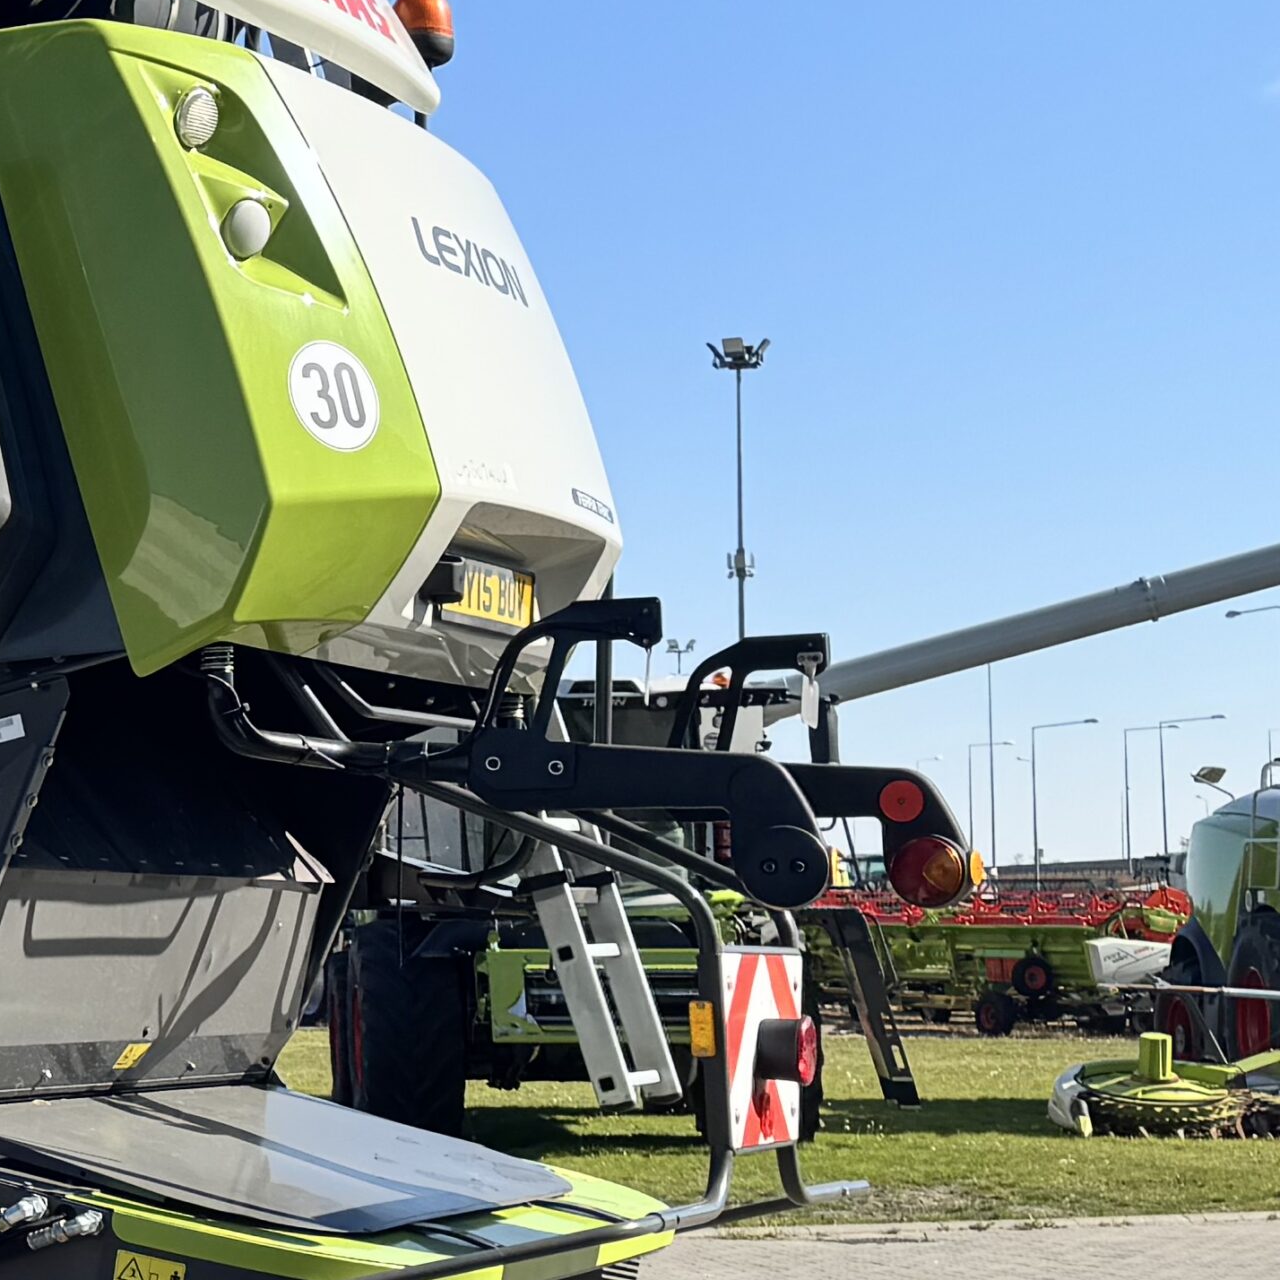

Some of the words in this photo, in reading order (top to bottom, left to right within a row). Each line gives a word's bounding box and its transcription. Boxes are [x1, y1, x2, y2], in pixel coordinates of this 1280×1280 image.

[410, 216, 529, 308] LEXION
[301, 362, 366, 429] 30
[458, 565, 492, 613] Y15
